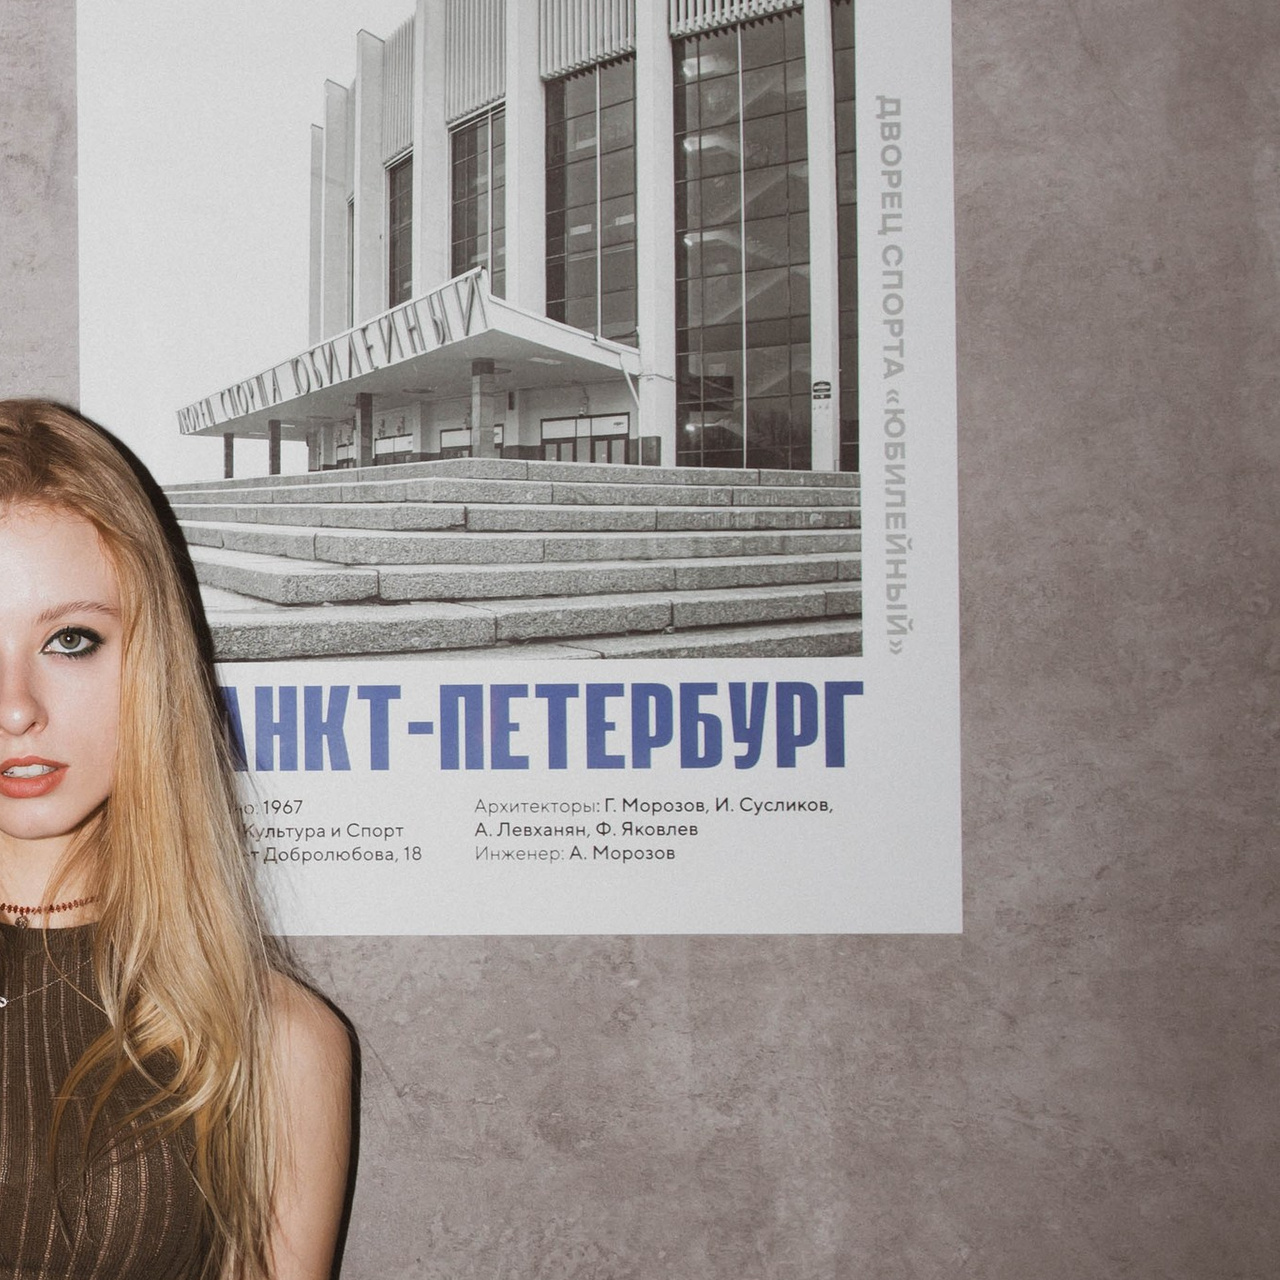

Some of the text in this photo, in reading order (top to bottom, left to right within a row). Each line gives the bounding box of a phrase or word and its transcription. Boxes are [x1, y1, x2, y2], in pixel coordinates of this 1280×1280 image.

[875, 94, 914, 655] ДВОРЕЦ СПОРТА «ЮБИЛЕЙНЫЙ»
[220, 681, 864, 771] НКТ-ПЕТЕРБУРГ
[263, 800, 303, 815] 1967
[474, 797, 834, 816] Архитекторы: Г. Морозов, И. Сусликов,
[243, 823, 404, 842] Культура и Спорт
[474, 822, 699, 839] А. Левханян, Ф. Яковлев
[263, 846, 399, 864] Добролюбова,
[404, 846, 422, 861] 18
[475, 846, 676, 864] Инженер: А. Морозов
